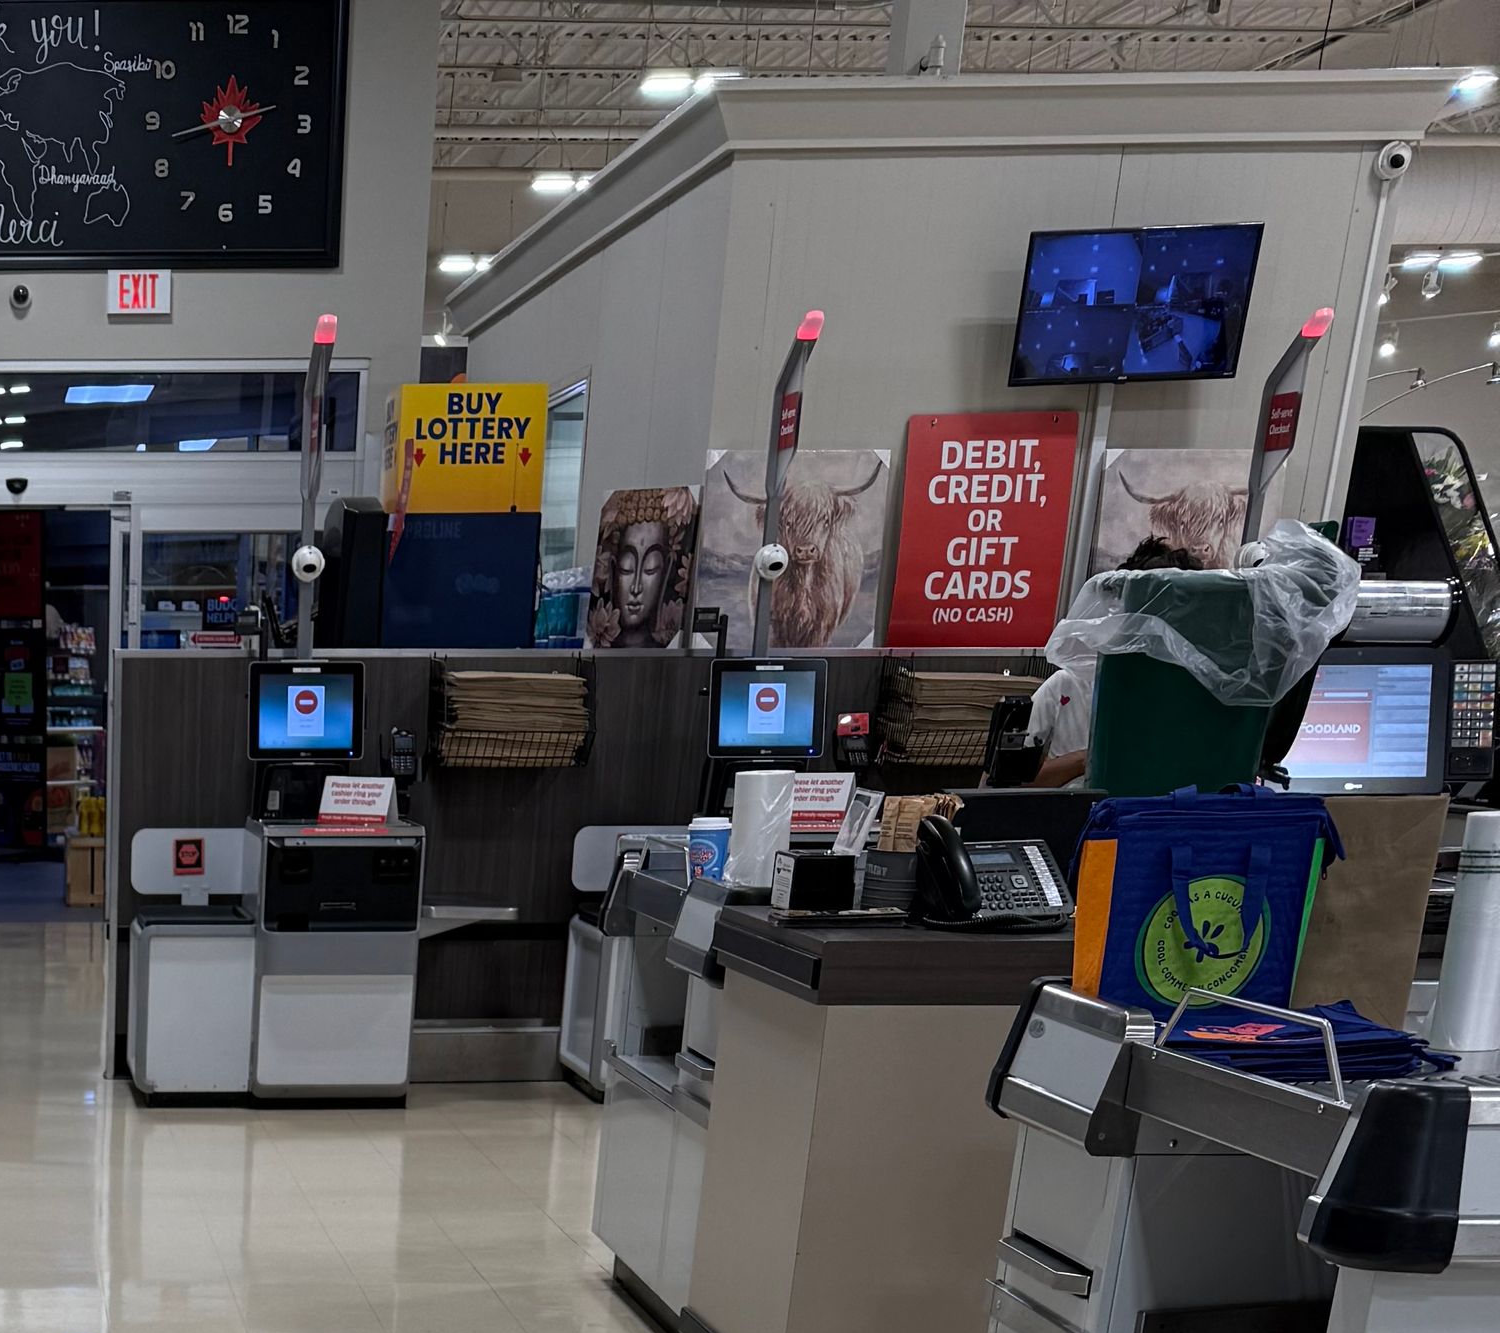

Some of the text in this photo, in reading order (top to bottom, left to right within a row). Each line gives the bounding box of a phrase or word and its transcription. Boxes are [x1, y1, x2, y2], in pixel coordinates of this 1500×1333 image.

[189, 21, 204, 41] 11
[227, 14, 249, 34] 12
[30, 9, 100, 64] you!
[271, 29, 279, 48] 1
[153, 60, 176, 79] 10
[294, 66, 310, 85] 2
[145, 111, 160, 130] 9
[297, 114, 312, 134] 3
[155, 158, 169, 178] 8
[287, 158, 301, 178] 4
[180, 192, 196, 211] 7
[258, 195, 272, 214] 5
[218, 203, 233, 222] 6
[119, 273, 159, 309] EXIT
[447, 392, 502, 415] BUY
[1271, 407, 1293, 419] Self-serve
[415, 417, 531, 440] LOTTERY
[1269, 423, 1290, 435] Checkout
[439, 442, 505, 465] HERE
[940, 438, 1041, 473] DEBIT,
[928, 473, 1047, 508] CREDIT,
[967, 509, 1003, 532] OR
[946, 536, 1019, 566] GIFT
[924, 570, 1031, 601] CARDS
[932, 606, 1013, 625] (NO CASH)
[1164, 910, 1178, 929] COO
[1204, 890, 1211, 899] A
[1158, 940, 1249, 991] COOL COMME CONCOMB
